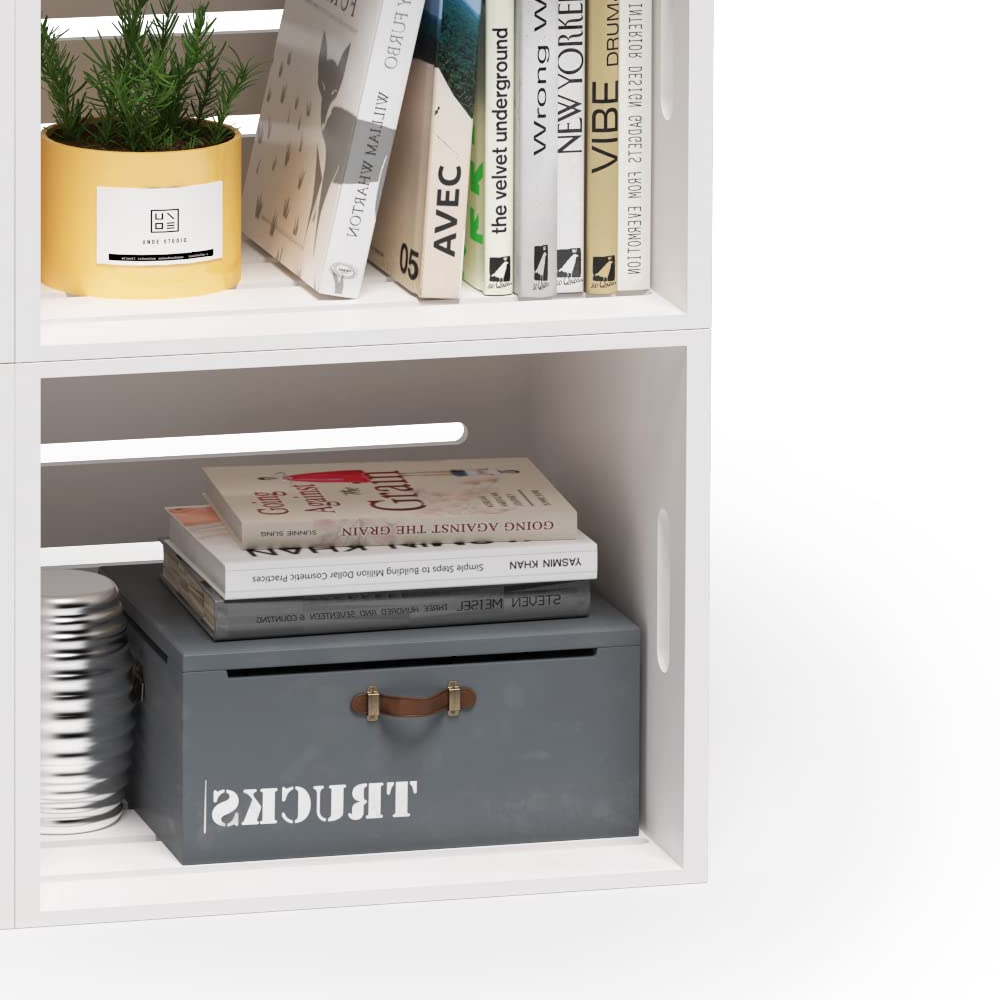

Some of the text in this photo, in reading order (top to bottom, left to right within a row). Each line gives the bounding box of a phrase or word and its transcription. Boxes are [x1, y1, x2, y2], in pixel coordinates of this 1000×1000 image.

[534, 45, 550, 156] Wrong
[492, 28, 510, 234] the velvet underground
[558, 94, 582, 154] NEW
[592, 80, 618, 174] VIBE
[433, 165, 462, 257] AVEC
[400, 242, 419, 280] 05
[293, 484, 340, 513] Against
[354, 470, 427, 511] Grain
[252, 491, 289, 515] Going
[342, 521, 554, 536] GOING AGAINST THE GRAIN
[357, 569, 384, 577] Million
[386, 566, 419, 576] Building
[422, 566, 430, 574] to
[433, 564, 454, 574] Steps
[457, 563, 484, 572] Simple
[510, 557, 582, 570] YASMIN KHAN
[290, 572, 328, 580] Cosmetic
